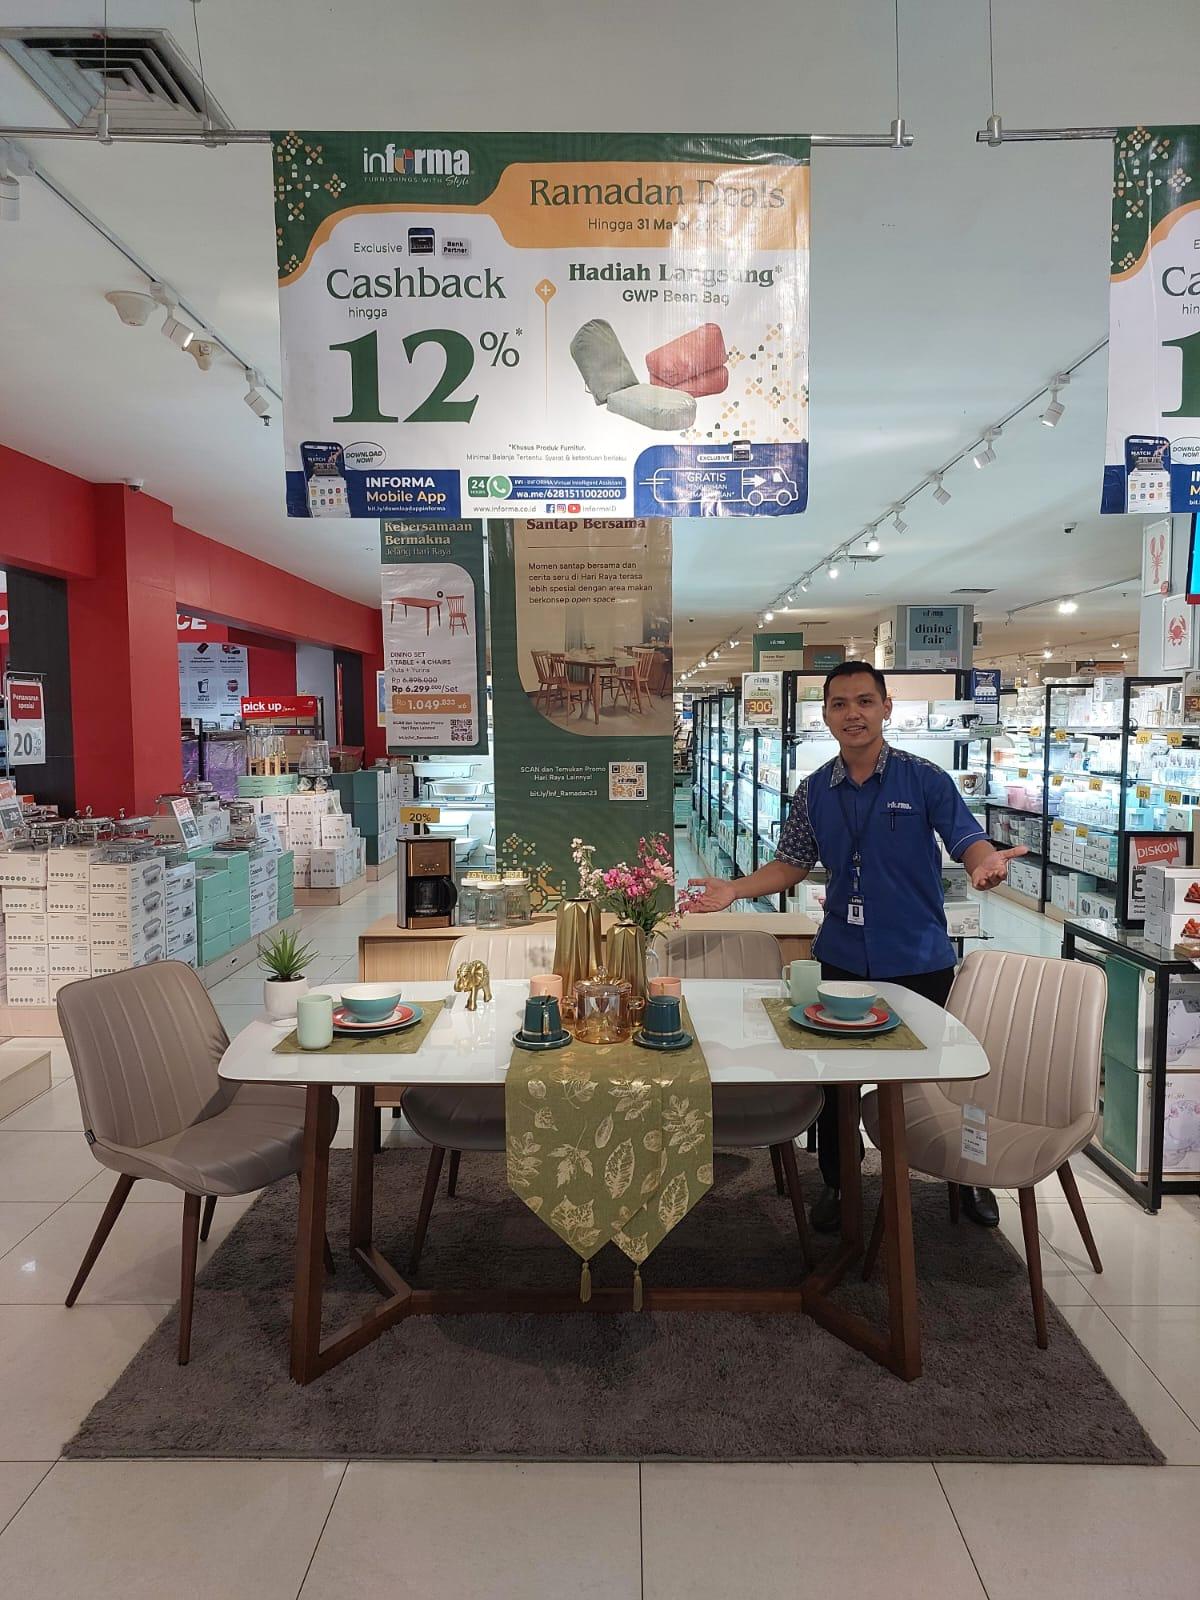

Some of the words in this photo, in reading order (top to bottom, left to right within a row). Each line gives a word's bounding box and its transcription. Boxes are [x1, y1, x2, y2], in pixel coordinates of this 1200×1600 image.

[363, 143, 470, 175] informa
[529, 177, 684, 206] Ramadan
[696, 178, 785, 209] Deals
[588, 218, 633, 232] Hingga
[637, 219, 650, 230] 31
[353, 242, 403, 253] Exclusive
[569, 263, 650, 281] Hadiah
[326, 266, 507, 299] Cashback
[622, 290, 659, 302] GWP
[663, 290, 698, 302] Bean
[703, 290, 729, 305] Bag
[348, 306, 387, 320] hingga
[467, 453, 491, 461] Minimal
[687, 472, 727, 482] GRATIS
[366, 477, 435, 488] INFORMA
[472, 480, 485, 489] 24
[366, 490, 413, 502] Mobile
[417, 491, 446, 505] App
[516, 489, 621, 499] wa.me/6281511002000
[473, 505, 537, 513] www.informa.co.id
[384, 522, 472, 532] Kebersamaan
[527, 518, 578, 532] Santap
[583, 518, 646, 529] Bersama
[385, 535, 450, 545] Bermakna
[560, 563, 585, 572] santap
[571, 573, 579, 581] di
[581, 573, 597, 581] Hari
[599, 573, 617, 583] Raya
[529, 585, 548, 593] lebih
[550, 585, 576, 595] spesial
[578, 585, 606, 594] dengan
[628, 584, 653, 592] makan
[529, 596, 569, 605] berkonsep
[572, 597, 591, 605] open
[915, 624, 952, 634] dining
[922, 635, 945, 644] fair
[392, 685, 402, 693] Rp
[243, 701, 265, 714] pick
[268, 702, 282, 713] up
[749, 701, 771, 712] 300
[550, 774, 564, 782] Raya
[409, 812, 432, 822] 20%
[1137, 842, 1177, 858] DISKON
